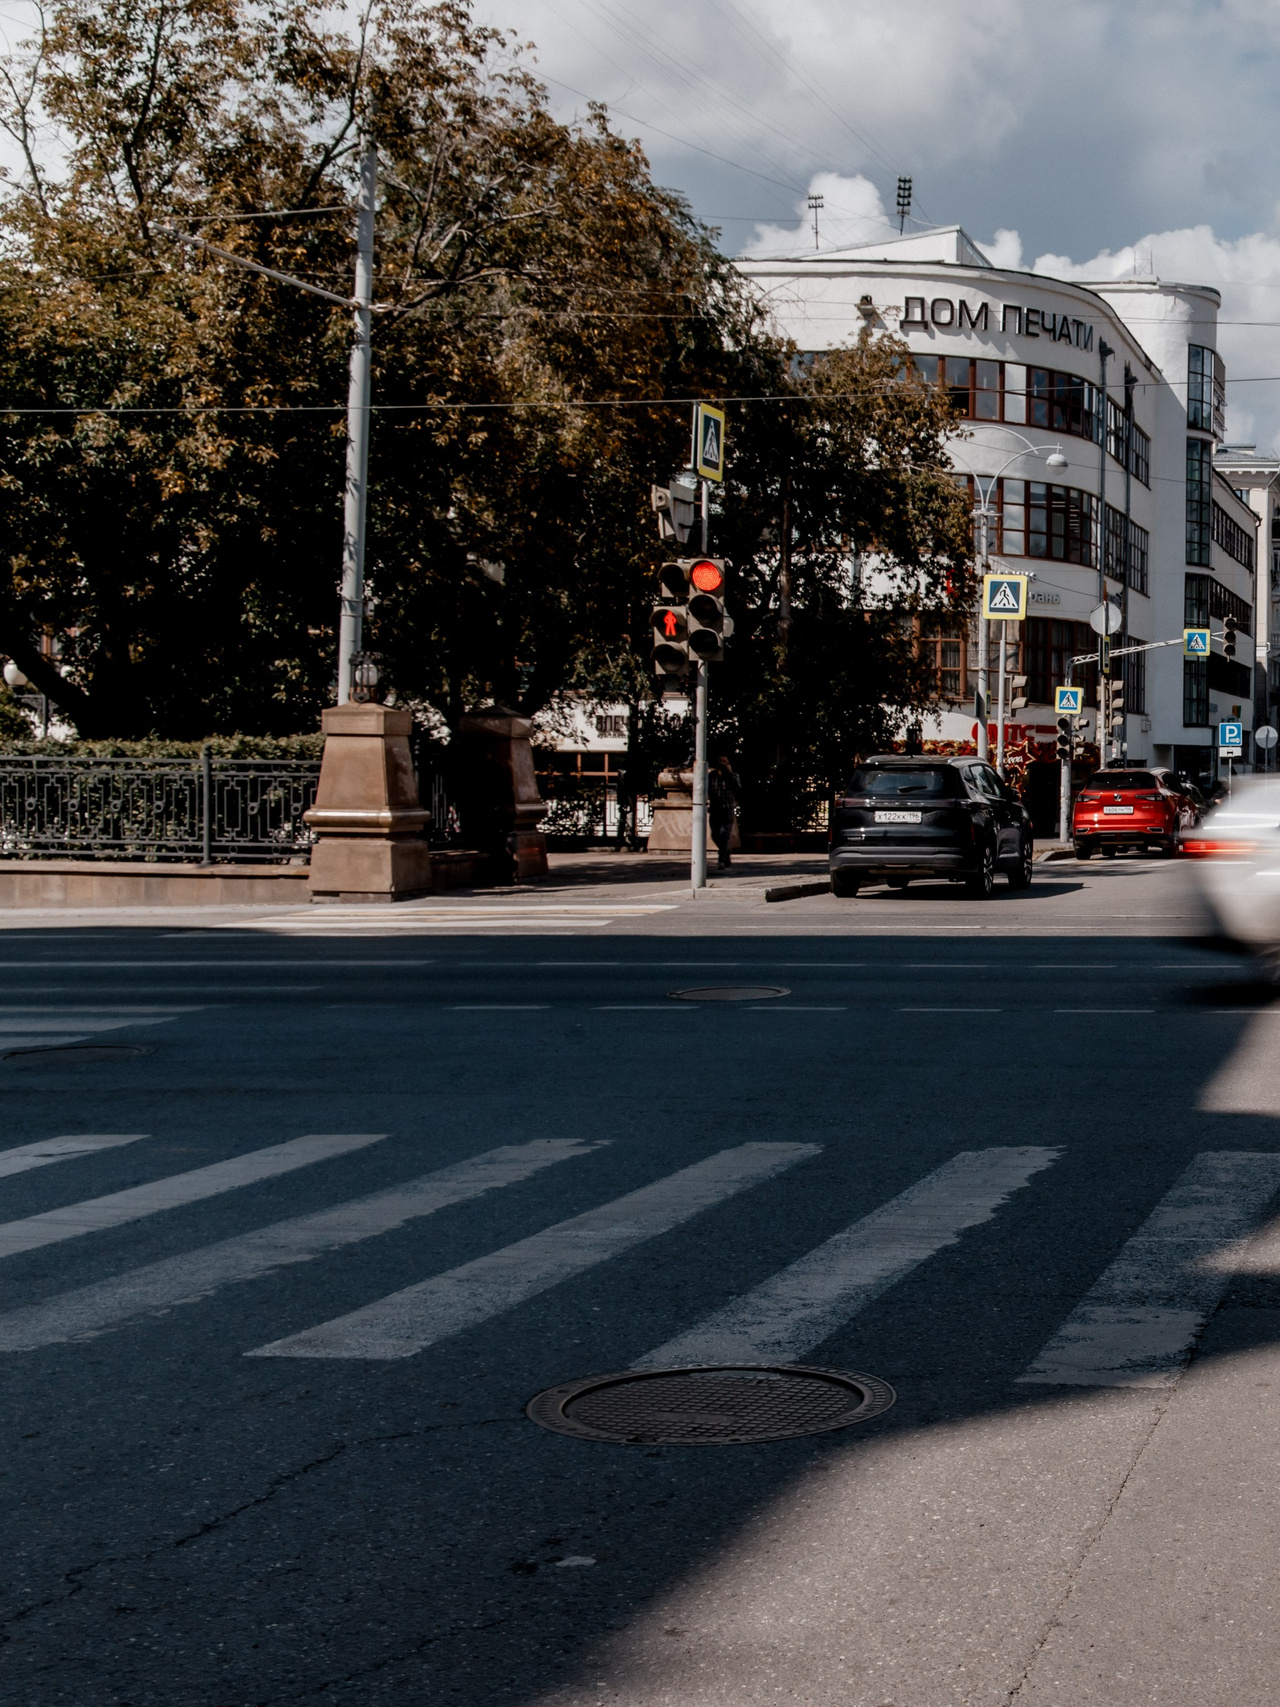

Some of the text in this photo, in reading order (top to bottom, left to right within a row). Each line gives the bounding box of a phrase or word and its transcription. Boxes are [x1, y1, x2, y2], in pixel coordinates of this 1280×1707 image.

[899, 296, 1093, 352] ДОМ ПЕЧАТИ
[1225, 725, 1239, 743] P
